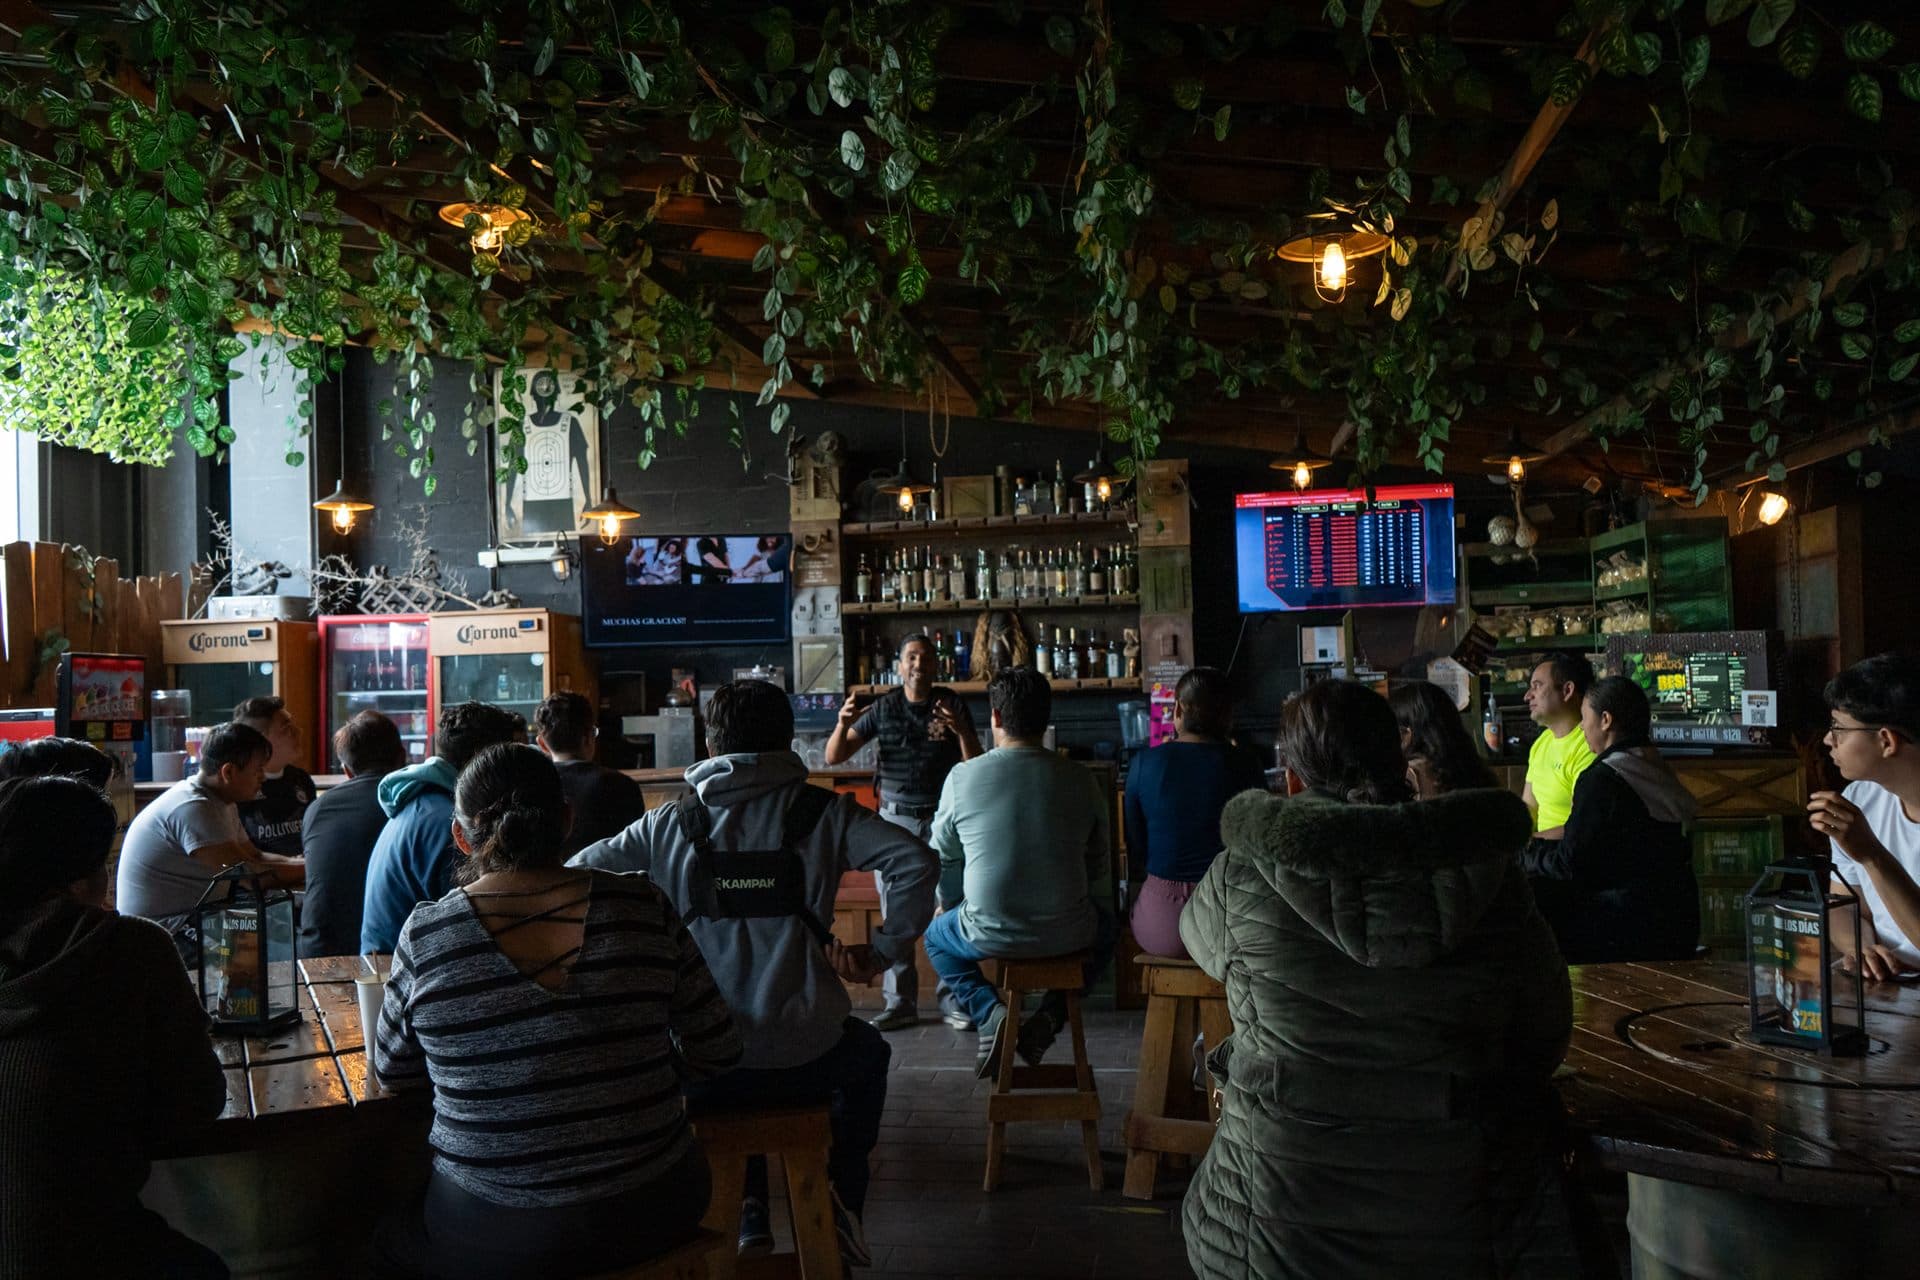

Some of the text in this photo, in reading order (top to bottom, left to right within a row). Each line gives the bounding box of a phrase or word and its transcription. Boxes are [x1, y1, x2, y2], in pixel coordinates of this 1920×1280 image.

[602, 617, 640, 625] MUCHAS
[189, 632, 248, 653] Corona
[457, 624, 518, 646] Corona
[1653, 728, 1685, 740] IMPRESA
[1691, 728, 1718, 740] DIGITAL
[1722, 728, 1742, 741] $120
[240, 916, 257, 931] DÍAS
[1798, 917, 1820, 935] DÍAS
